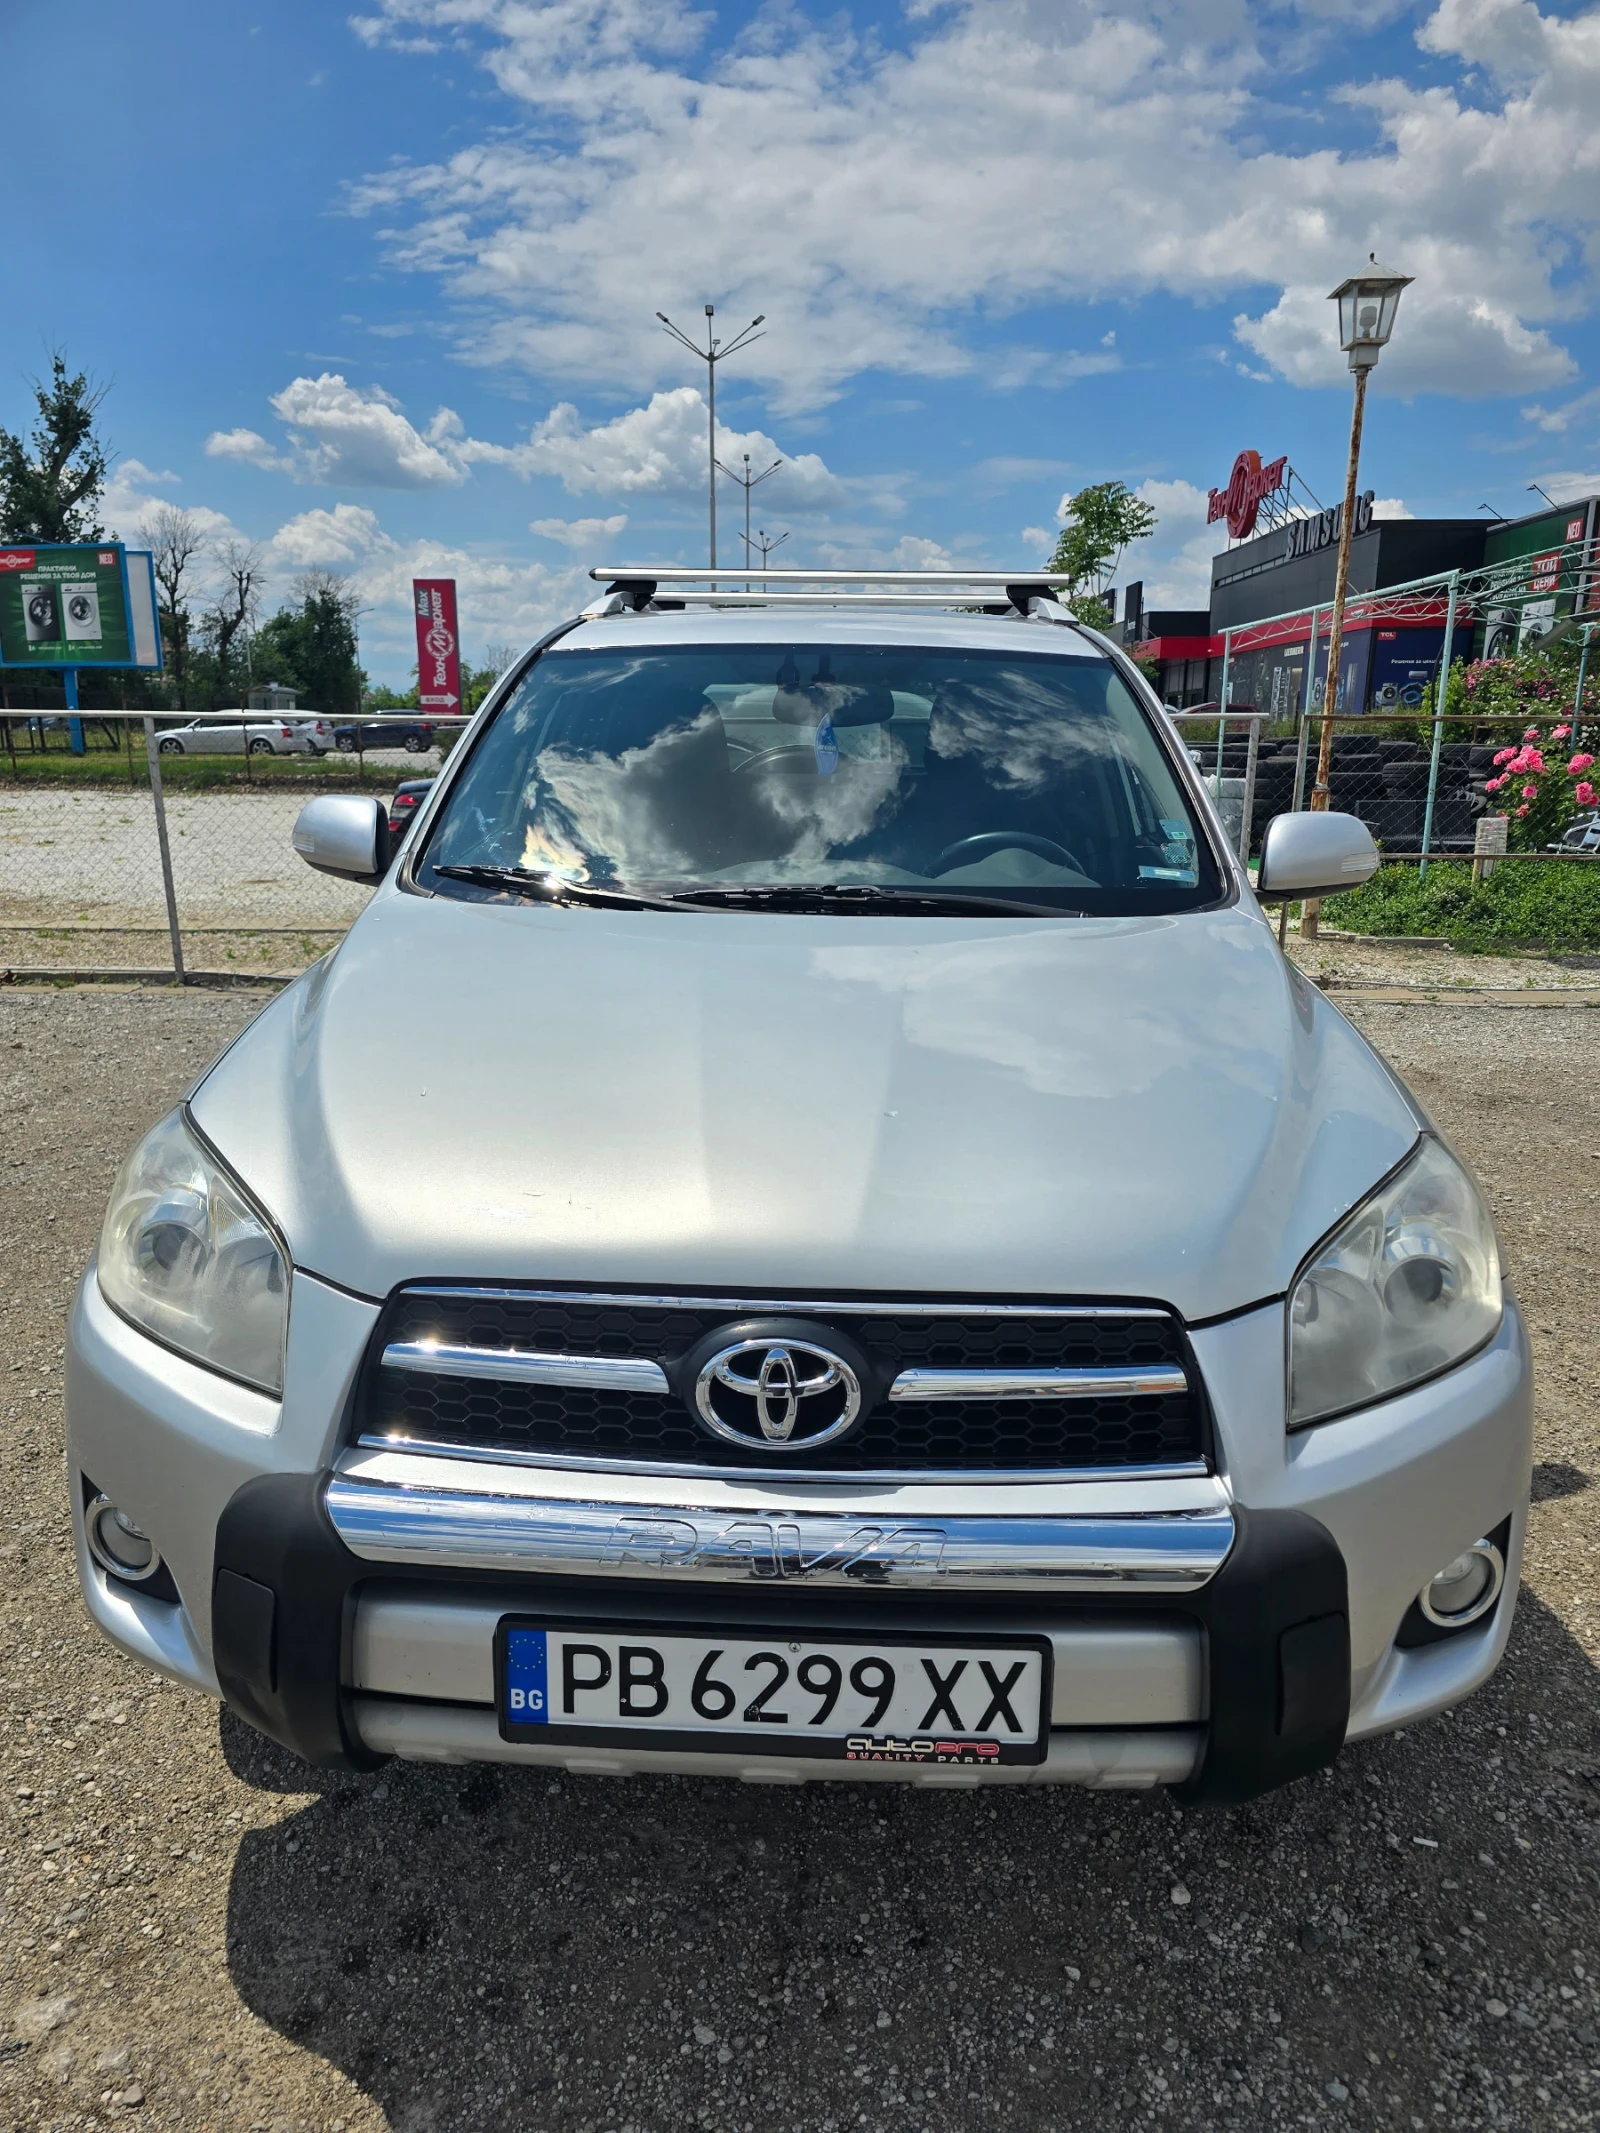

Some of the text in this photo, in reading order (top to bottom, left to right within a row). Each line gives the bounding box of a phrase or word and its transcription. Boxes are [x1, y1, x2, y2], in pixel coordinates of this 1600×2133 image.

[1567, 522, 1581, 540] NEO
[98, 553, 113, 565] NEO
[37, 565, 77, 573] ПРАКТИЧНИ
[80, 571, 97, 579] ДОМ
[417, 591, 429, 617] Max
[562, 1643, 1028, 1733] PB 6299 XX
[510, 1688, 543, 1710] BG
[846, 1751, 999, 1764] QUALITY PARTS
